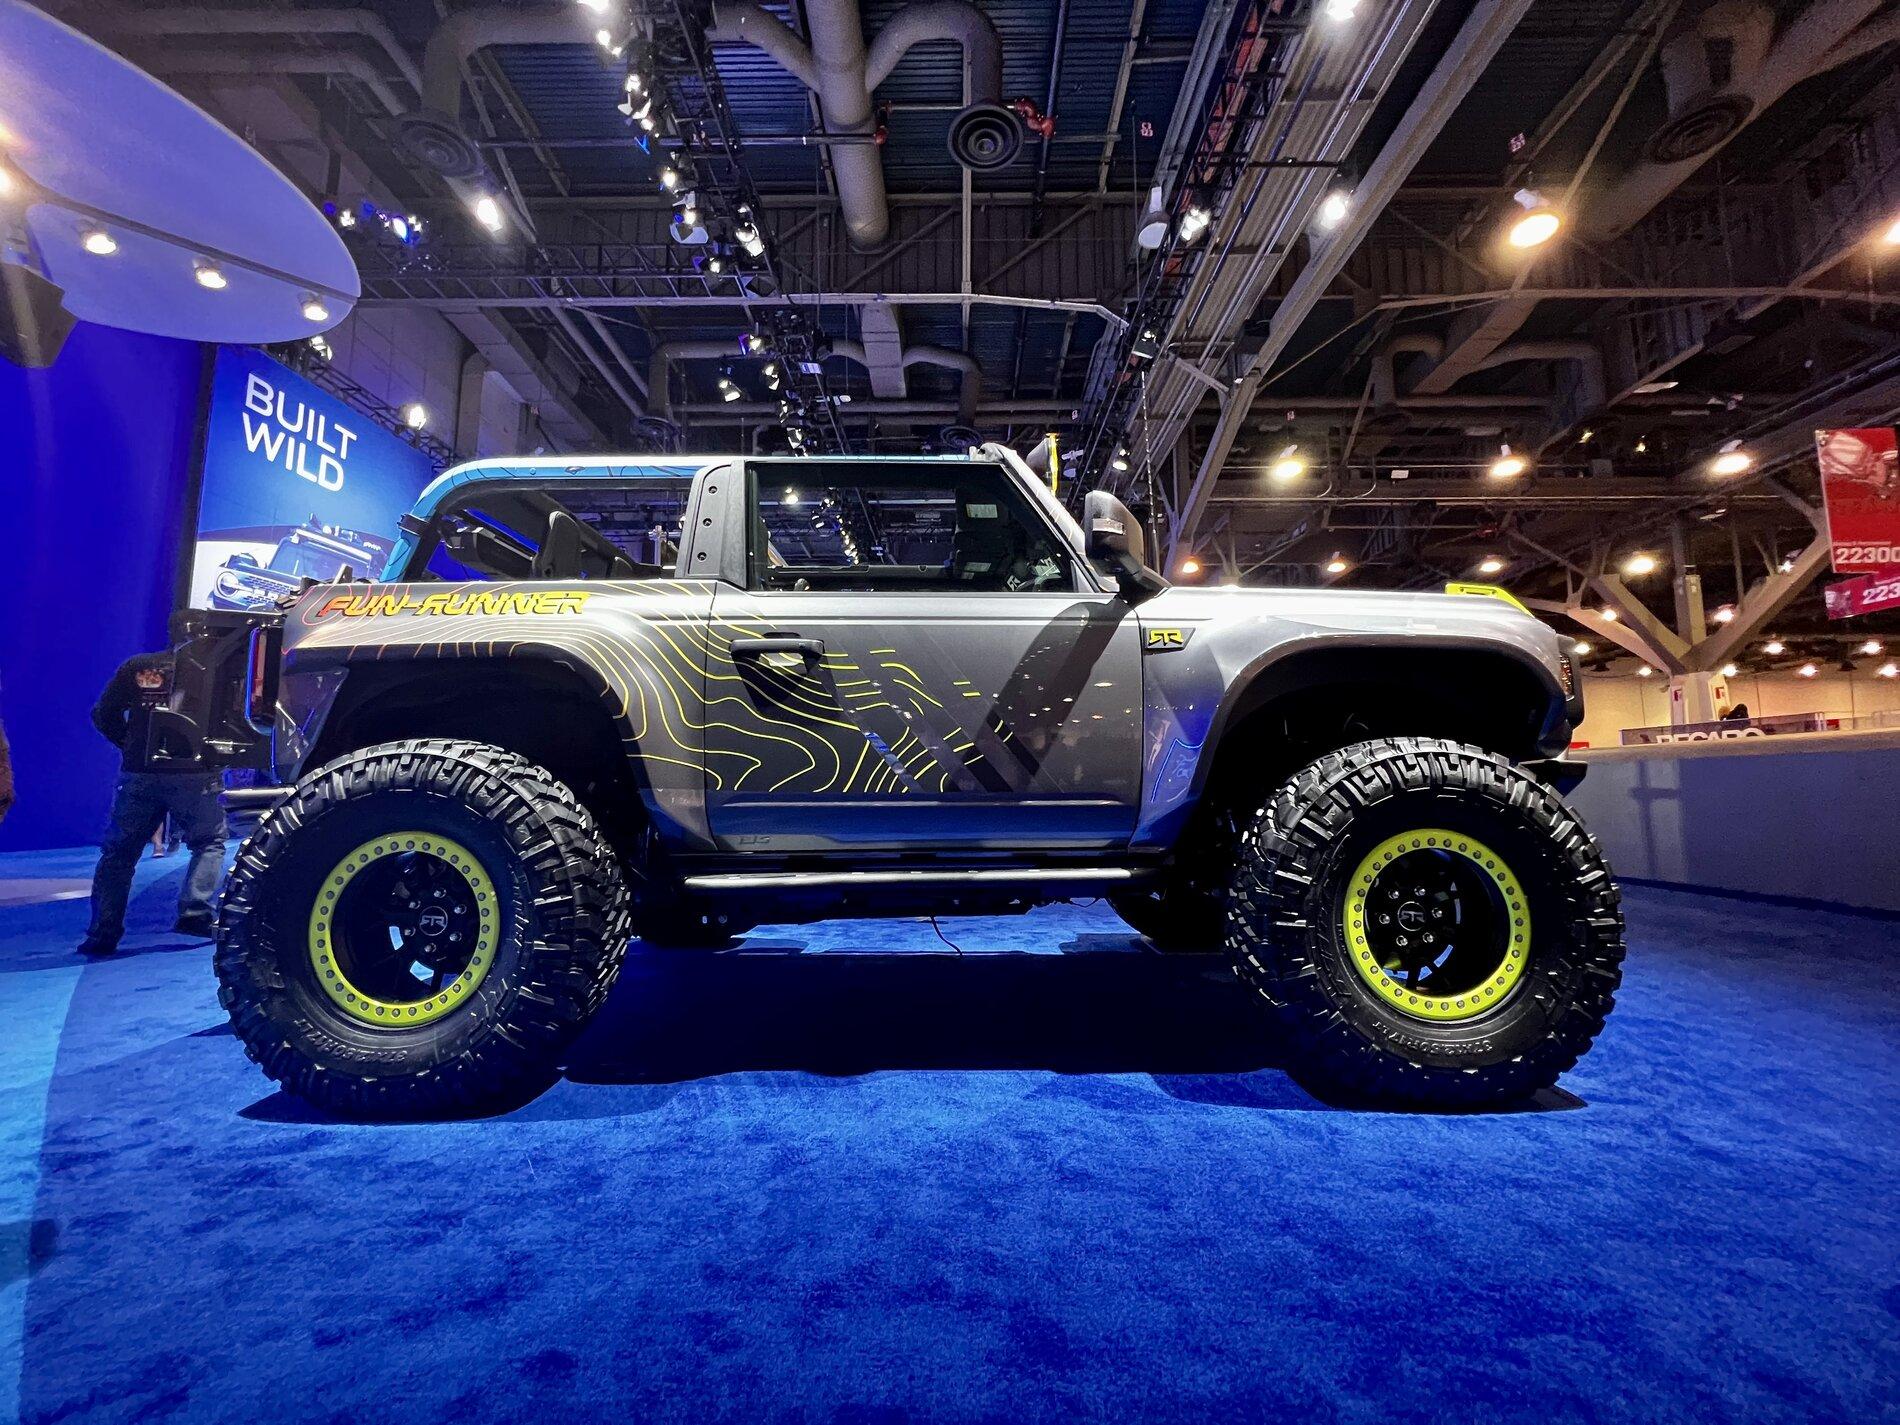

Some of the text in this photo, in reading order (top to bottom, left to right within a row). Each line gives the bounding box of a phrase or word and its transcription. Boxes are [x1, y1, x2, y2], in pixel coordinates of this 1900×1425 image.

[242, 411, 345, 492] WILD
[245, 372, 358, 461] BUILT
[316, 591, 591, 617] FUN-RUNNER
